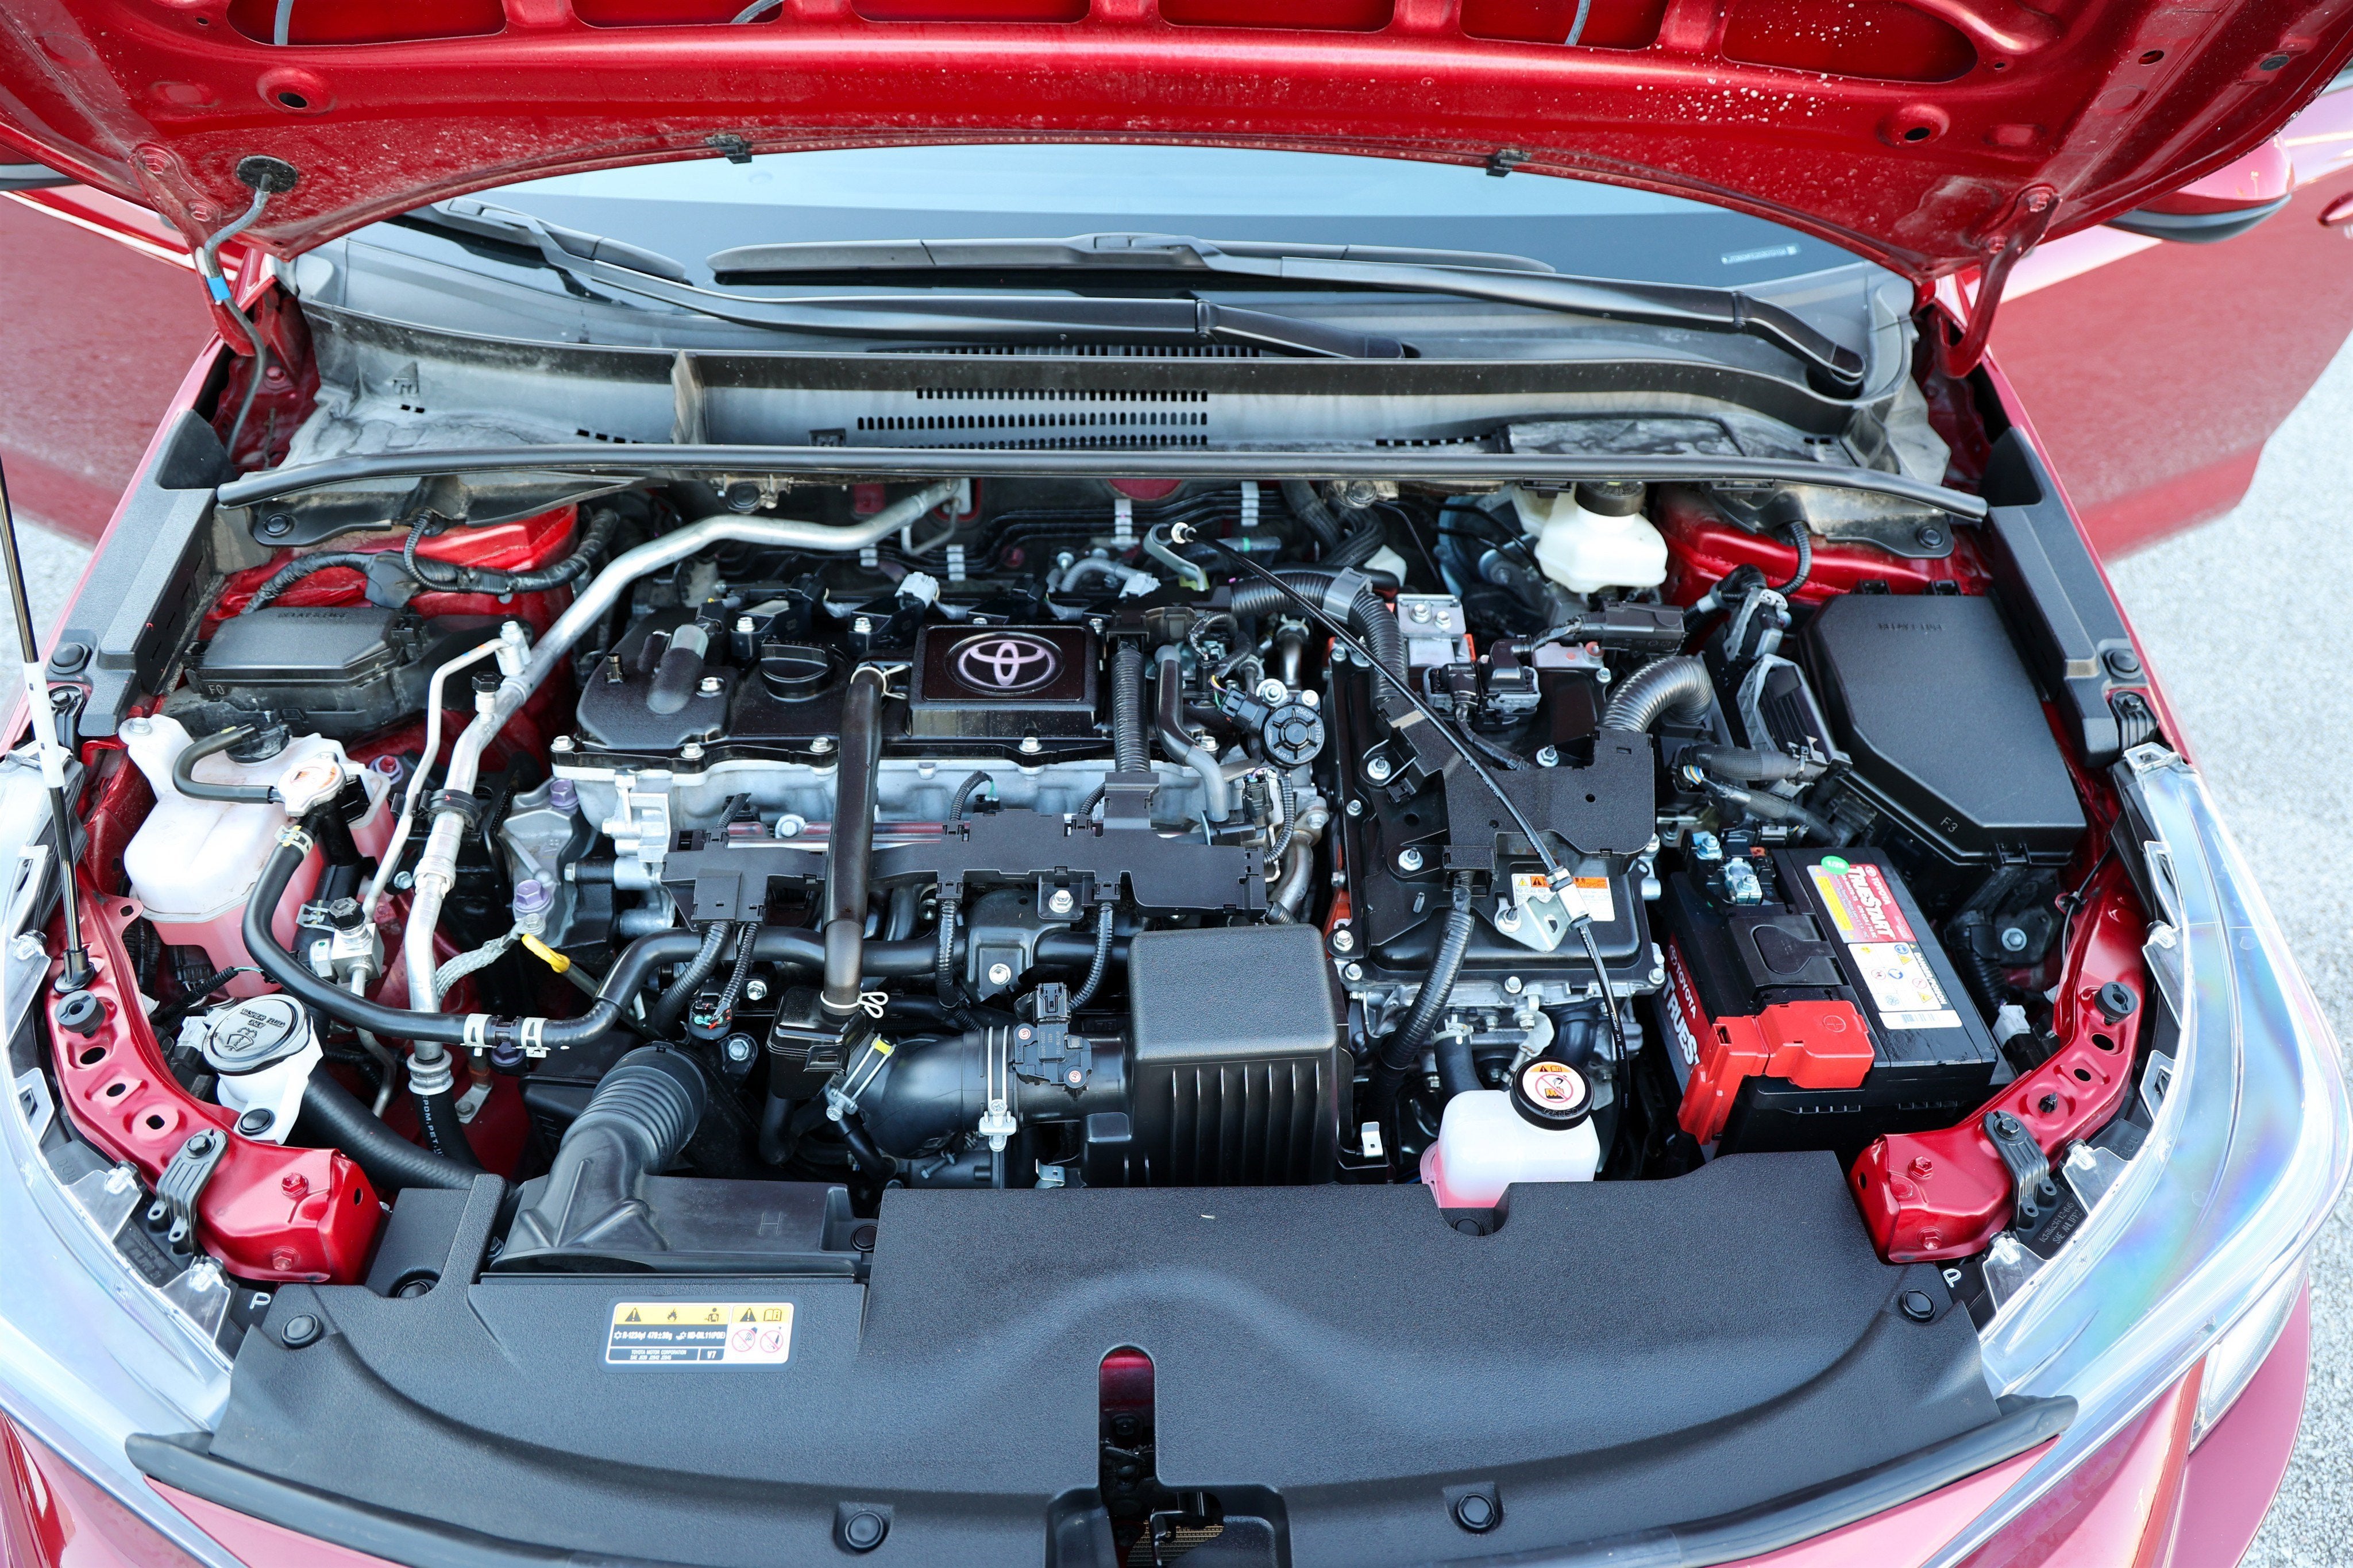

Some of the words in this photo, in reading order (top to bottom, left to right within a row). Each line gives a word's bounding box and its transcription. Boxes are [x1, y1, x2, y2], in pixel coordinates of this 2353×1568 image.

[1296, 706, 1314, 720] 25620
[1275, 750, 1290, 760] AJ01
[1299, 748, 1316, 760] TOYOTA
[1940, 816, 1958, 832] F3
[1871, 876, 1892, 905] TOYOTA
[1914, 952, 1947, 1005] DANGER/POISON
[1676, 961, 1696, 1019] TOYOTA
[1541, 1107, 1578, 1117] DENSO
[2053, 1231, 2065, 1244] SAE
[1942, 1269, 1962, 1289] P
[249, 1292, 271, 1310] P
[707, 1351, 716, 1360] V7
